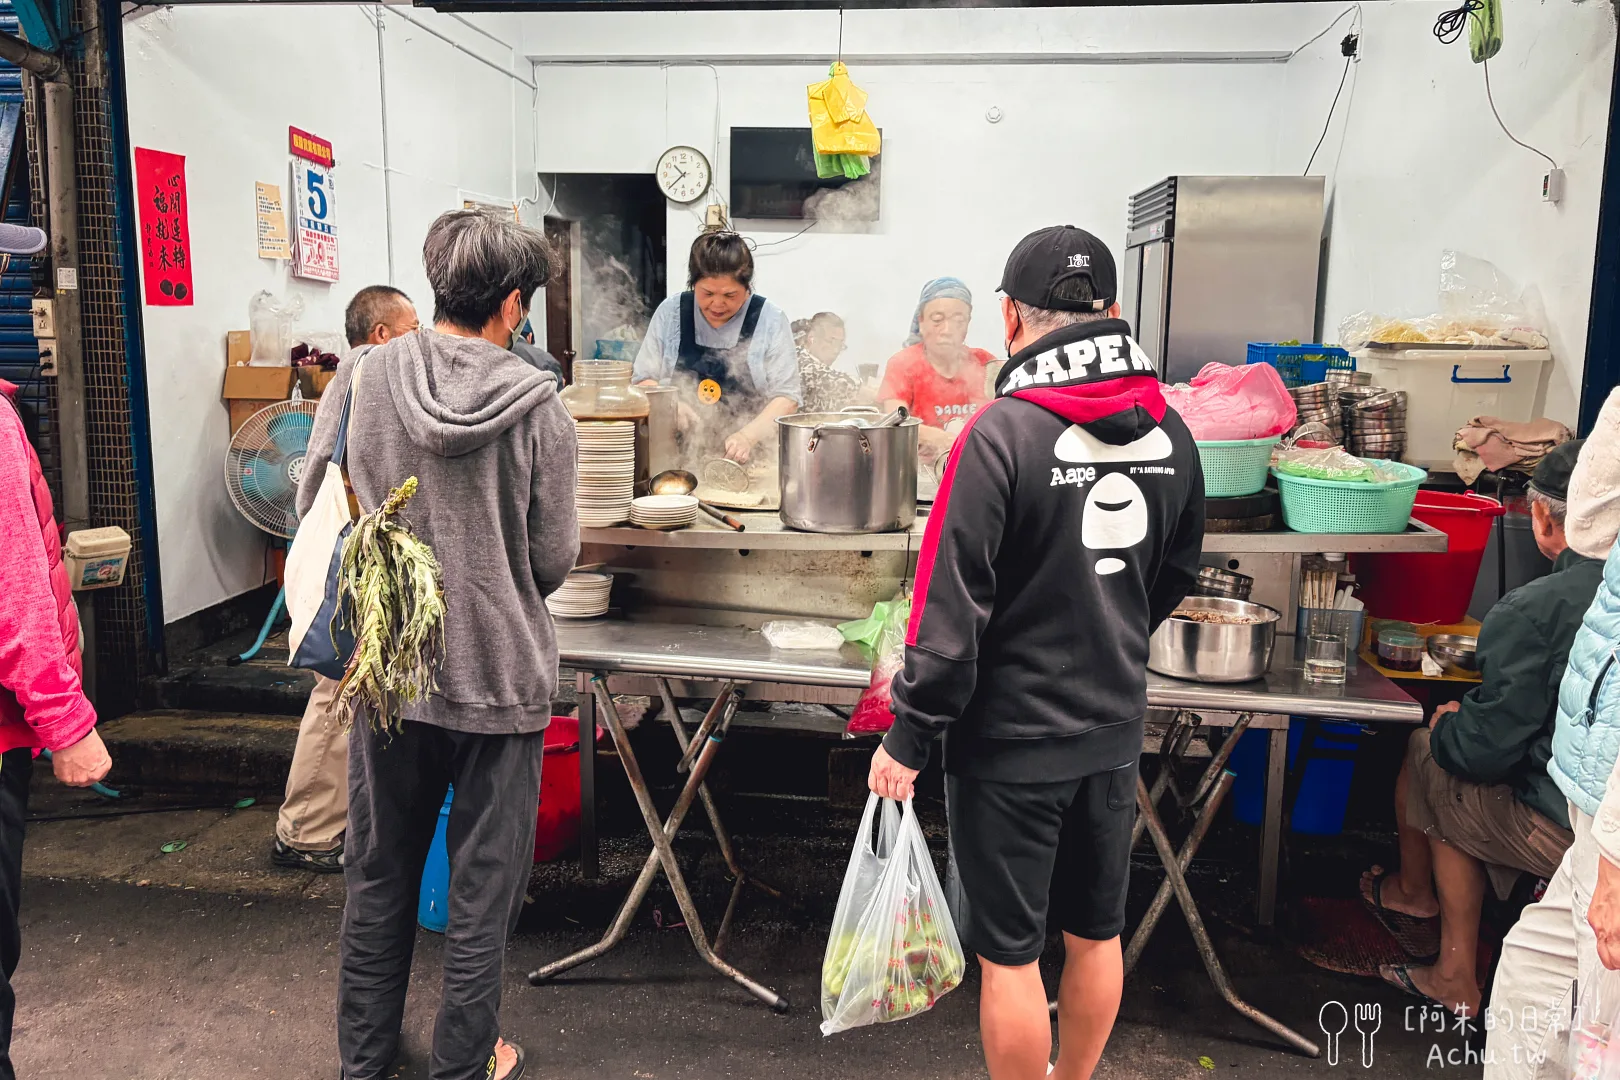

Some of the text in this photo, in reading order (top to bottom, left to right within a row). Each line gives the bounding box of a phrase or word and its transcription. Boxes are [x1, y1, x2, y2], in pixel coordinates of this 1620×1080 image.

[307, 169, 327, 219] 5
[168, 175, 185, 270] 心開運轉
[934, 403, 977, 416] DANCE
[1050, 466, 1096, 488] Aape
